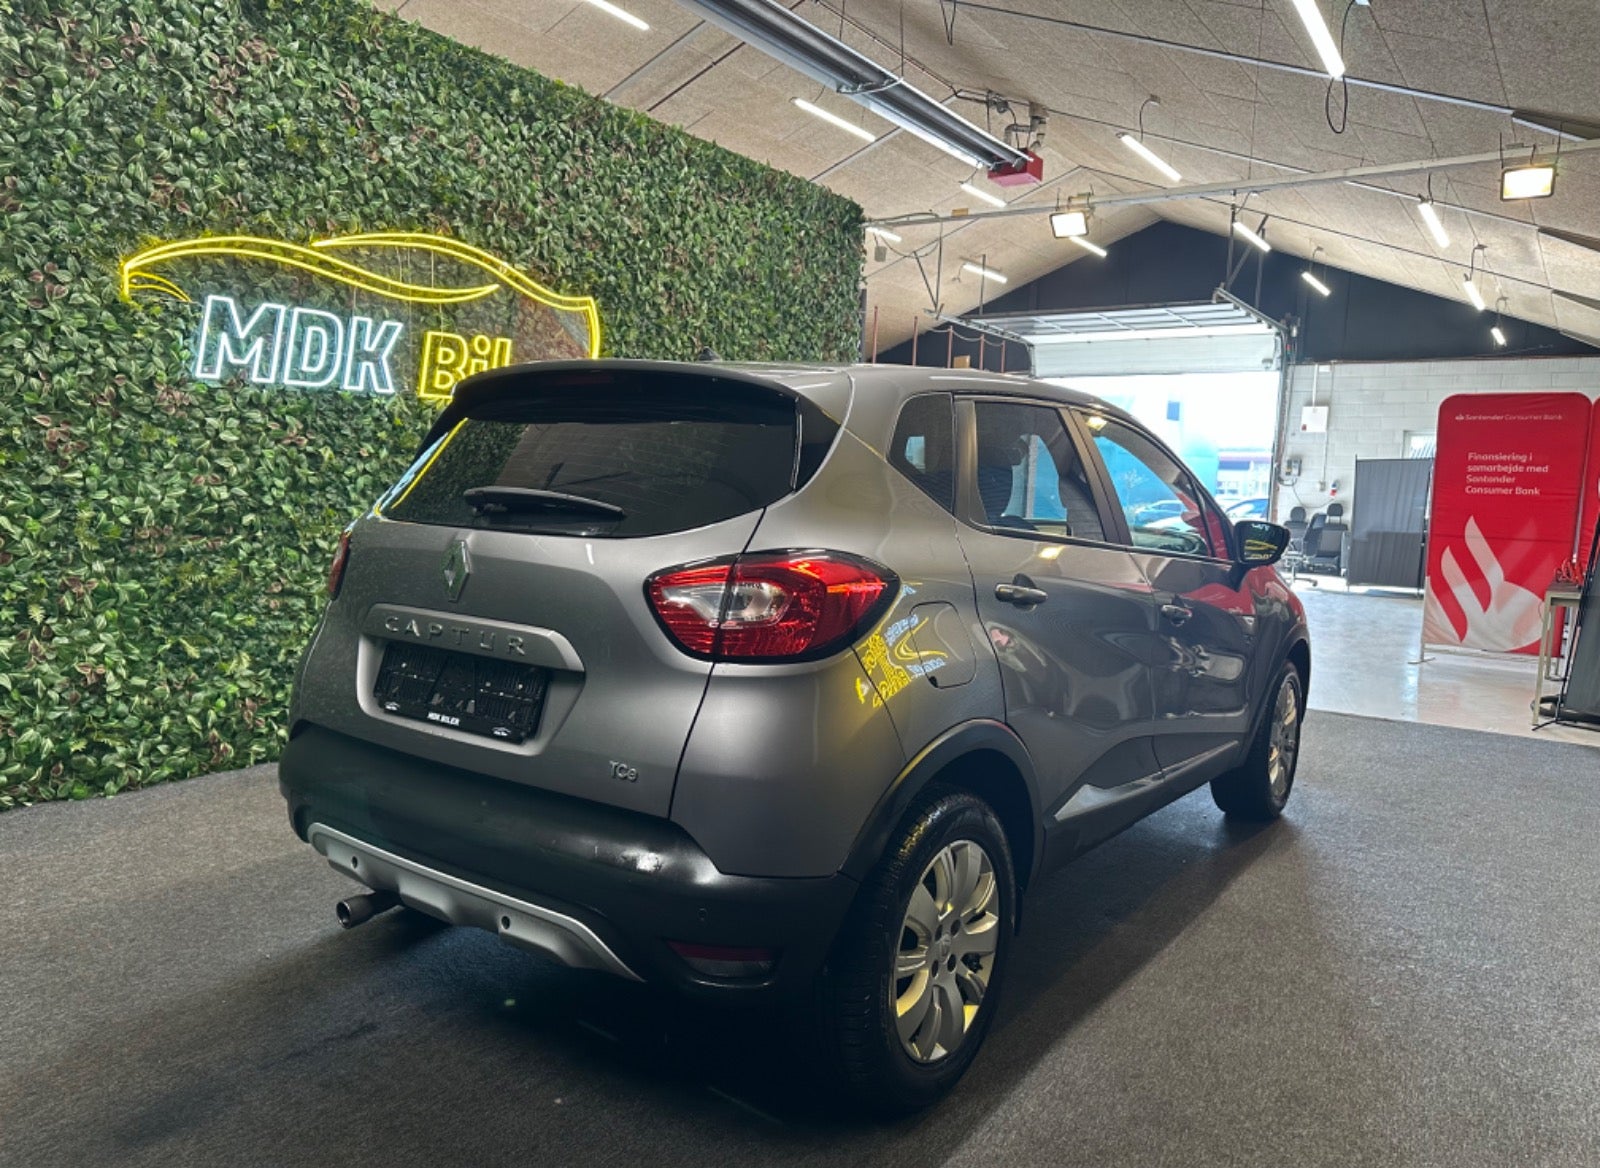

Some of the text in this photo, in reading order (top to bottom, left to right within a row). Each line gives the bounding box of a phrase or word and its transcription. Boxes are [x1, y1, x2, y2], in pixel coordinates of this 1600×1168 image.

[195, 295, 403, 394] MDK
[1467, 452, 1527, 463] Finansiering
[1467, 464, 1549, 474] samarbejde med
[1466, 474, 1516, 483] Santander
[1465, 485, 1540, 496] Consumer Bank
[385, 615, 526, 655] CAPTUR
[609, 760, 638, 782] TCe
